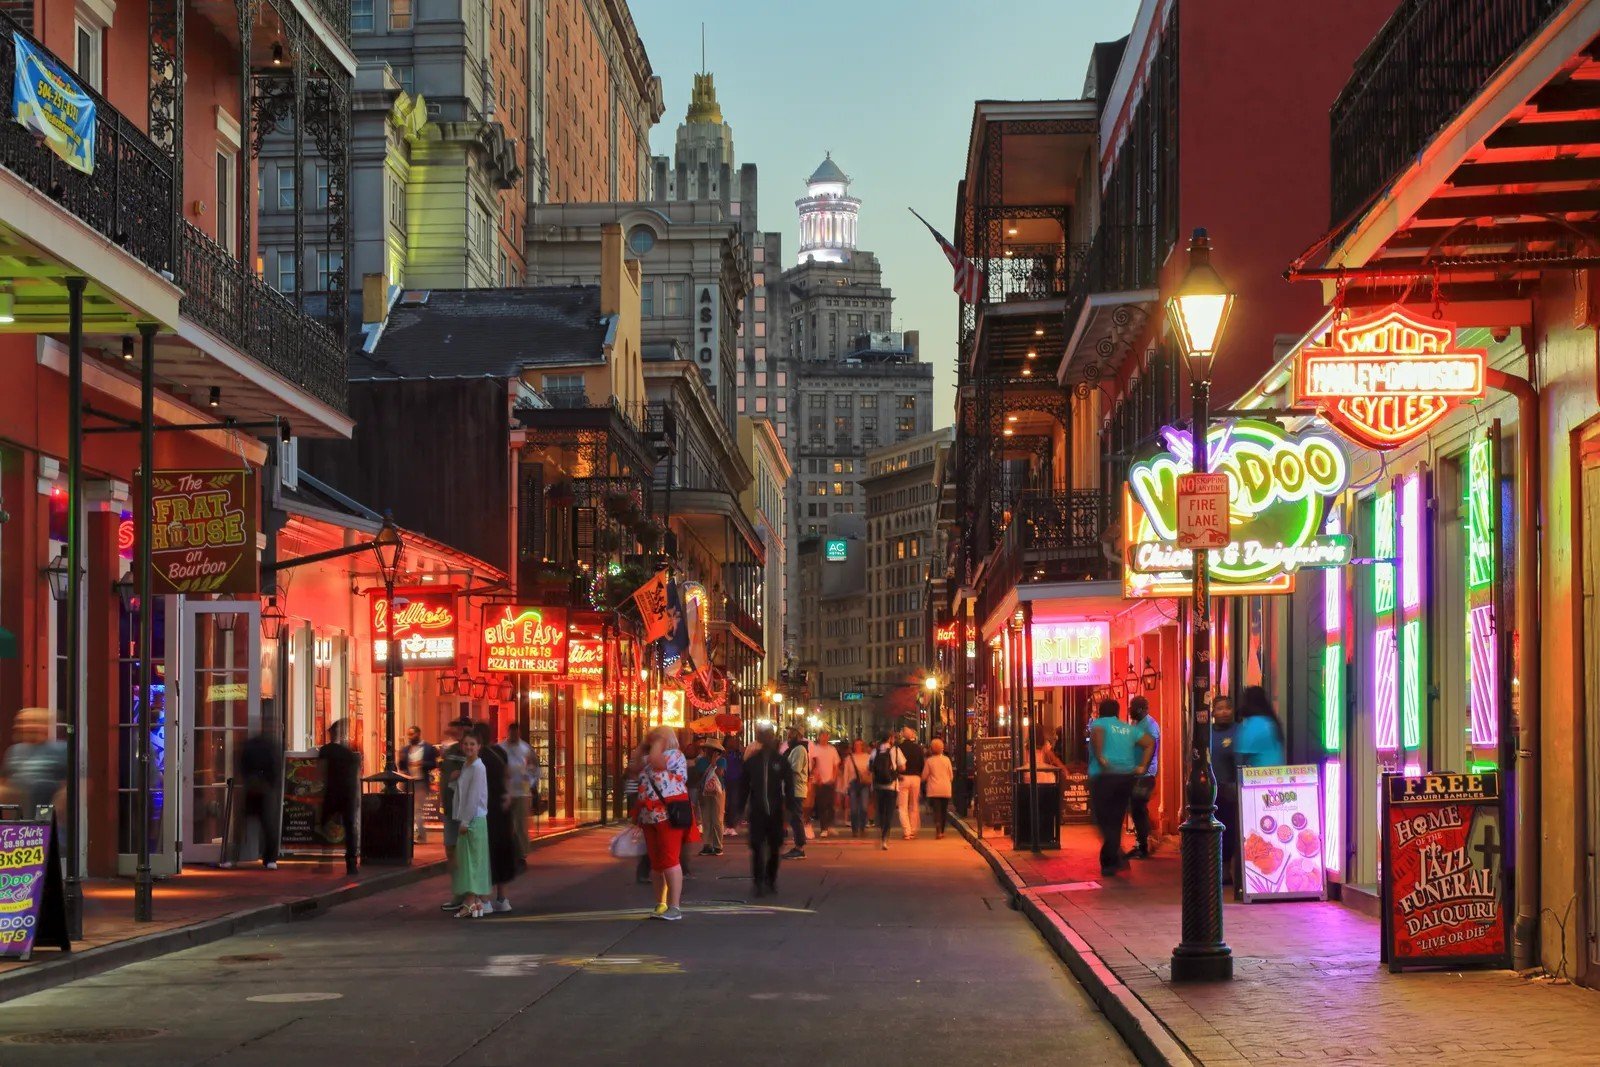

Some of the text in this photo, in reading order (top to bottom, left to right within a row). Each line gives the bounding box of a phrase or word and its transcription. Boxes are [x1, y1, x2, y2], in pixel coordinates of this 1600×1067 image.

[699, 287, 713, 384] ASTOR
[1349, 322, 1438, 354] MOTOR
[1351, 395, 1434, 432] CYCLES
[178, 474, 203, 491] The
[1130, 435, 1348, 541] VODOO
[1179, 477, 1196, 493] NO
[155, 494, 227, 522] FRAT
[1189, 499, 1217, 511] FIRE
[1187, 514, 1219, 527] LANE
[186, 551, 202, 562] on
[829, 543, 845, 551] AC
[1243, 540, 1346, 570] Daiquiris
[169, 558, 227, 578] Bourbon
[485, 621, 563, 646] BIG EASY
[1034, 635, 1104, 661] STLER
[488, 658, 559, 670] PIZZA BY THE SLICE
[980, 750, 1012, 761] HUSTLE
[985, 762, 1011, 773] CLU
[1246, 766, 1316, 777] DRAFT BEER
[1404, 774, 1483, 794] FREE
[1394, 804, 1462, 844] HOME
[26, 837, 43, 846] each
[1415, 831, 1443, 846] OF THE
[0, 848, 42, 867] 3x$24
[1414, 843, 1472, 890] JAZZ
[1400, 868, 1496, 914] FUNERAL
[1406, 901, 1496, 935] DAIQUIRI
[1448, 932, 1464, 943] OR
